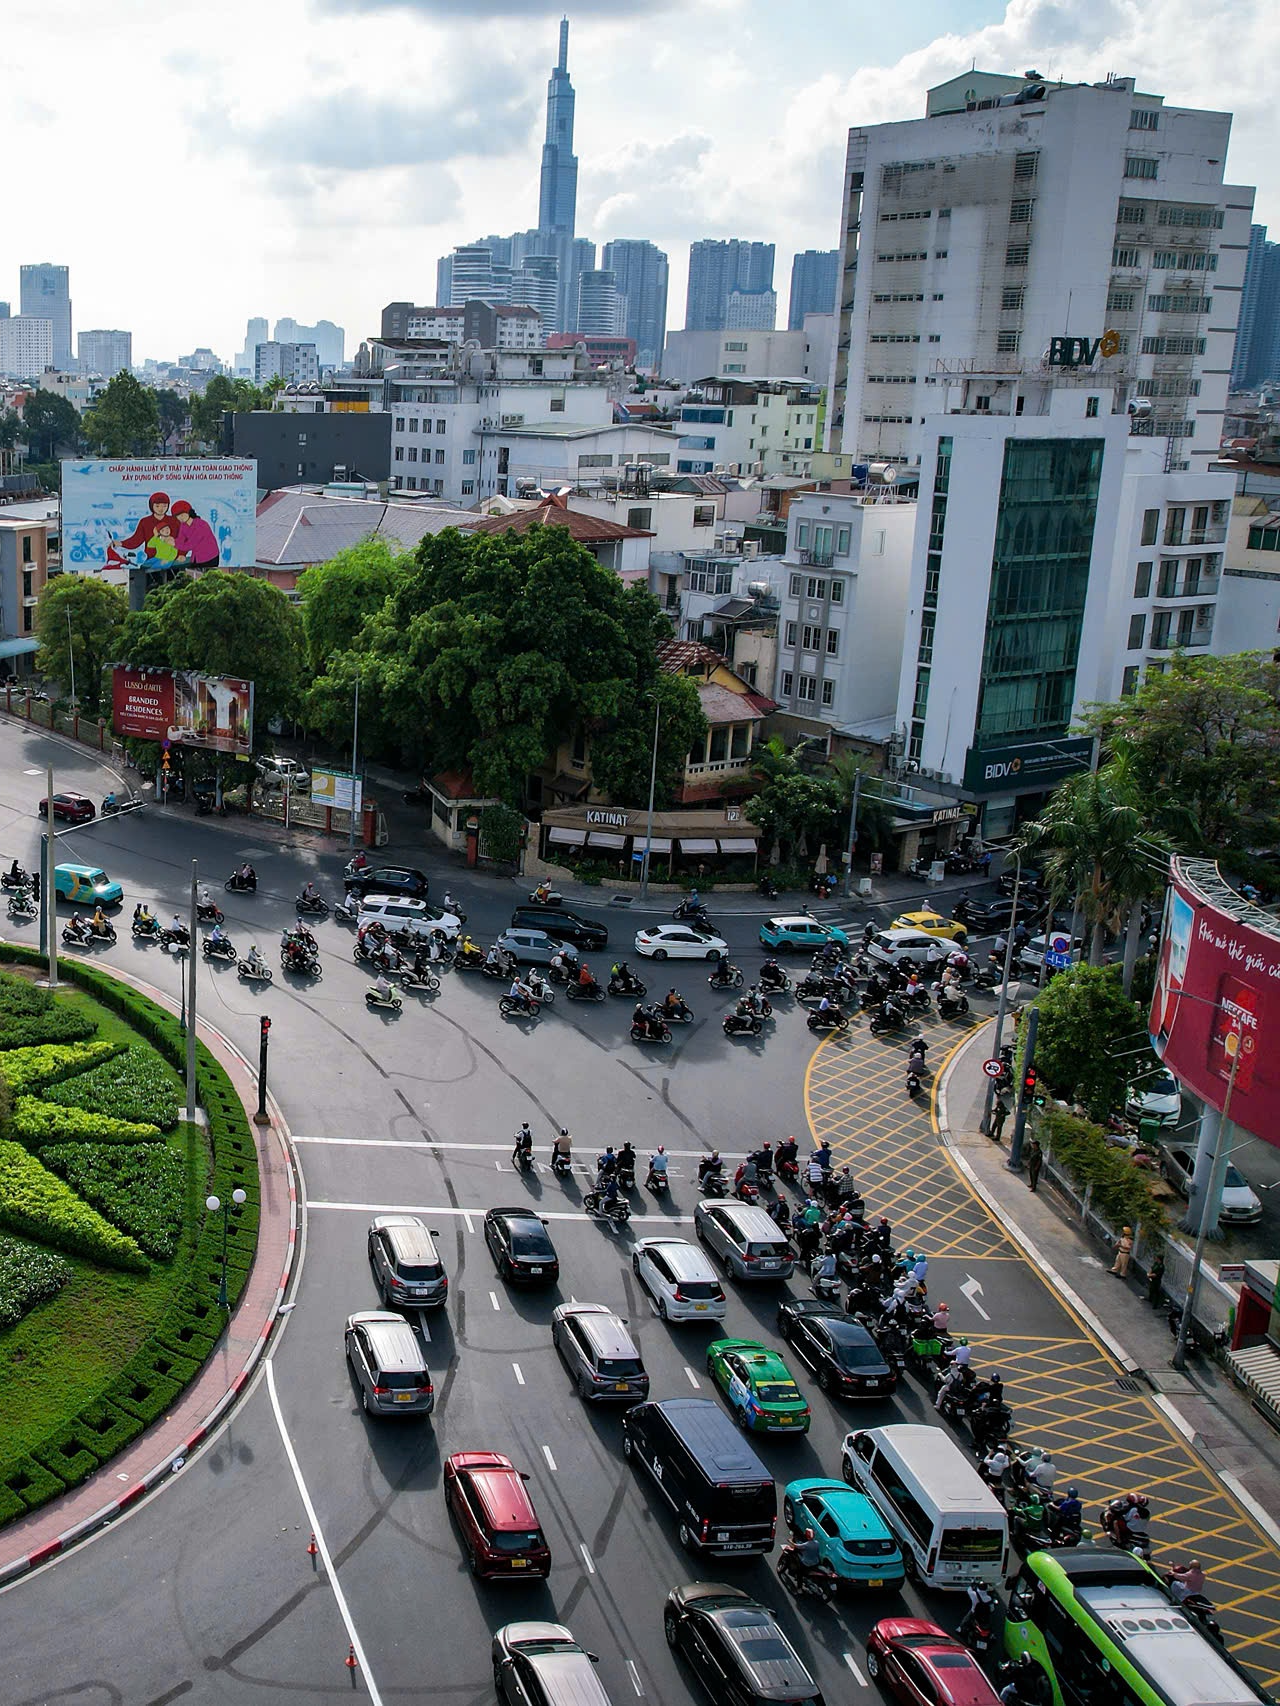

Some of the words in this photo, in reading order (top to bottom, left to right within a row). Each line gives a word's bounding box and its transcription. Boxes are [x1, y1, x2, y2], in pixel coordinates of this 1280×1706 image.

[1049, 336, 1104, 366] BIDV
[128, 696, 159, 706] BRANDED
[125, 704, 163, 716] RESIDENCES
[984, 761, 1013, 780] BIDV
[586, 810, 628, 827] KATINAT
[932, 807, 961, 824] KATINAT
